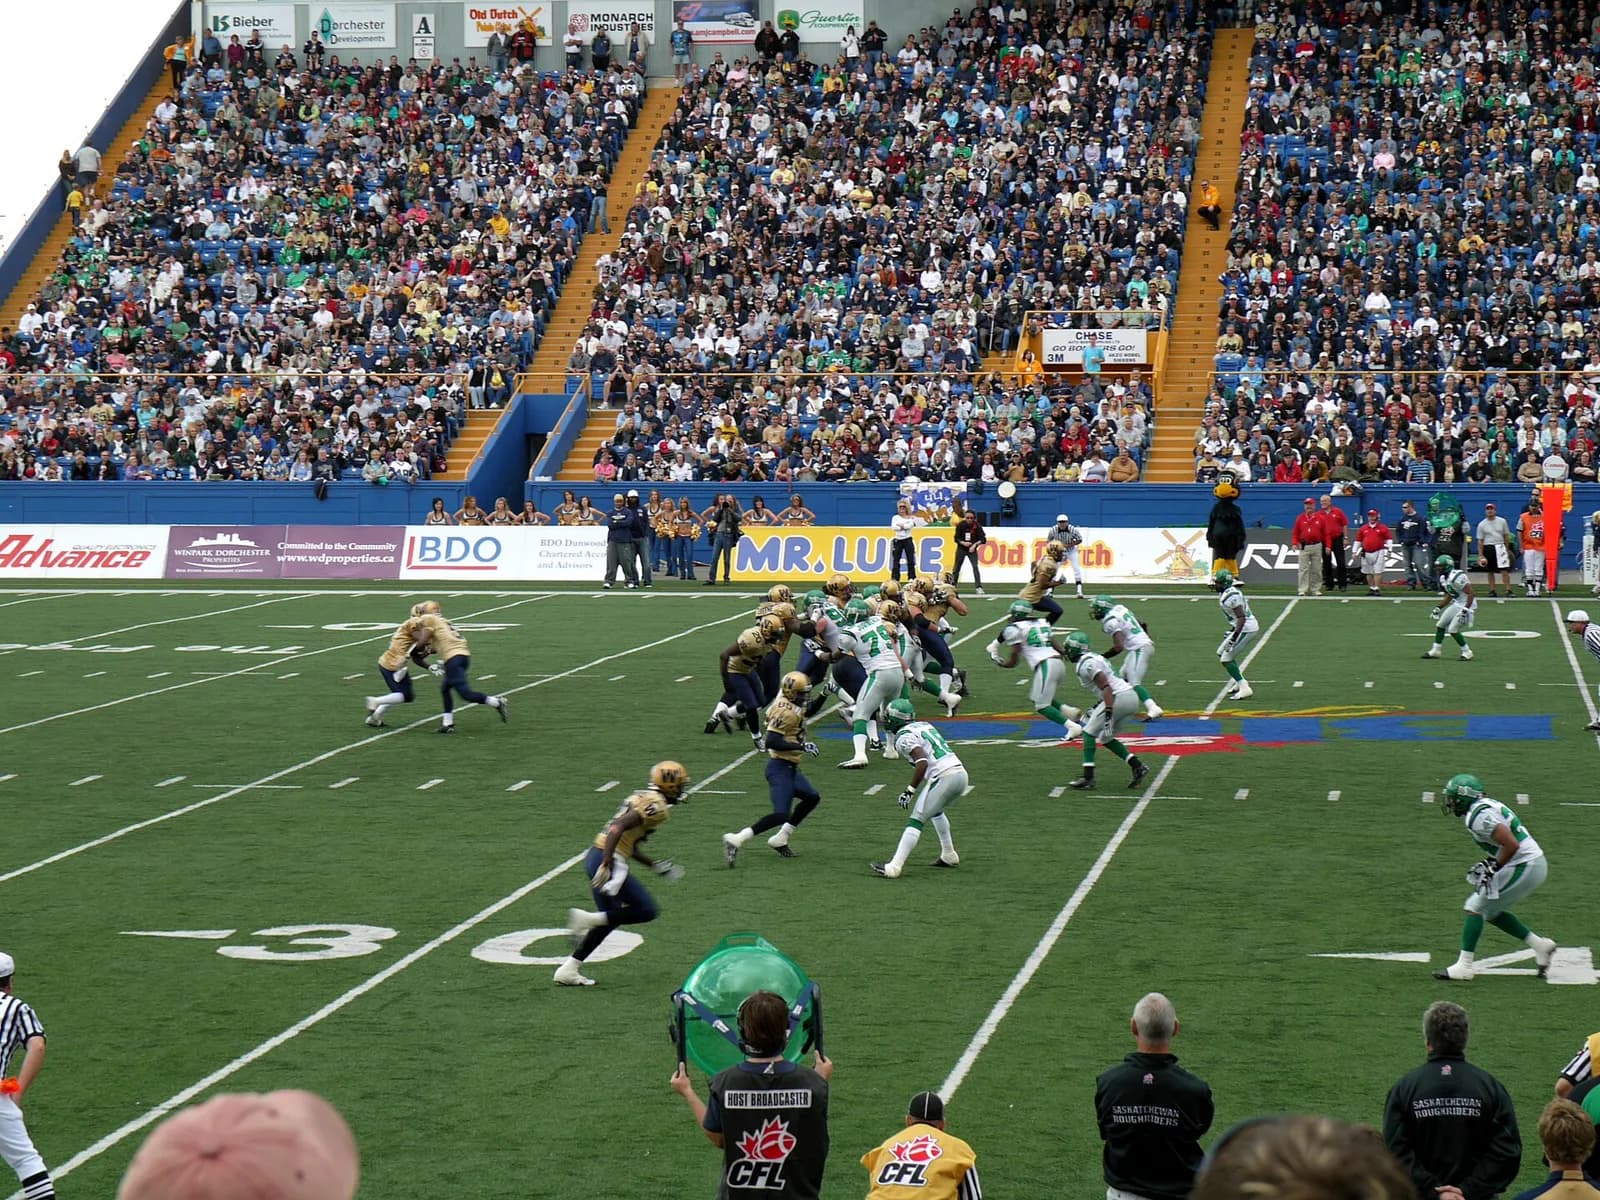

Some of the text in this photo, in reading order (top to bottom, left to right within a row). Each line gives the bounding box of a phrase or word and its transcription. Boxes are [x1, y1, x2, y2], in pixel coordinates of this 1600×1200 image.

[469, 8, 518, 20] Old Dutch
[590, 13, 654, 22] MONARCH
[233, 16, 274, 27] Bieber
[320, 18, 385, 33] Dorchester
[415, 16, 432, 34] A
[590, 23, 654, 32] INDUSTES
[330, 34, 386, 45] Developments
[1075, 331, 1113, 340] CHASE
[1047, 354, 1064, 362] 3M
[277, 542, 398, 552] Committed to the Community
[540, 539, 607, 547] BDO Dunwood
[0, 534, 152, 568] Advance
[418, 536, 501, 563] BDO
[978, 539, 1112, 567] Old Dch
[276, 553, 394, 566] www.wdproperties.ca
[537, 561, 593, 569] and Advisors
[216, 924, 645, 965] 3 0
[727, 1092, 809, 1106] HOST BROADCASTER
[1412, 1098, 1482, 1110] SASKATCHEWAN
[1112, 1105, 1180, 1118] SASKATCHEWAN
[1414, 1107, 1481, 1118] ROUGHRIDERS
[1113, 1115, 1178, 1126] ROUGHRIDERS
[727, 1158, 786, 1190] CFL
[877, 1162, 928, 1186] CFL
